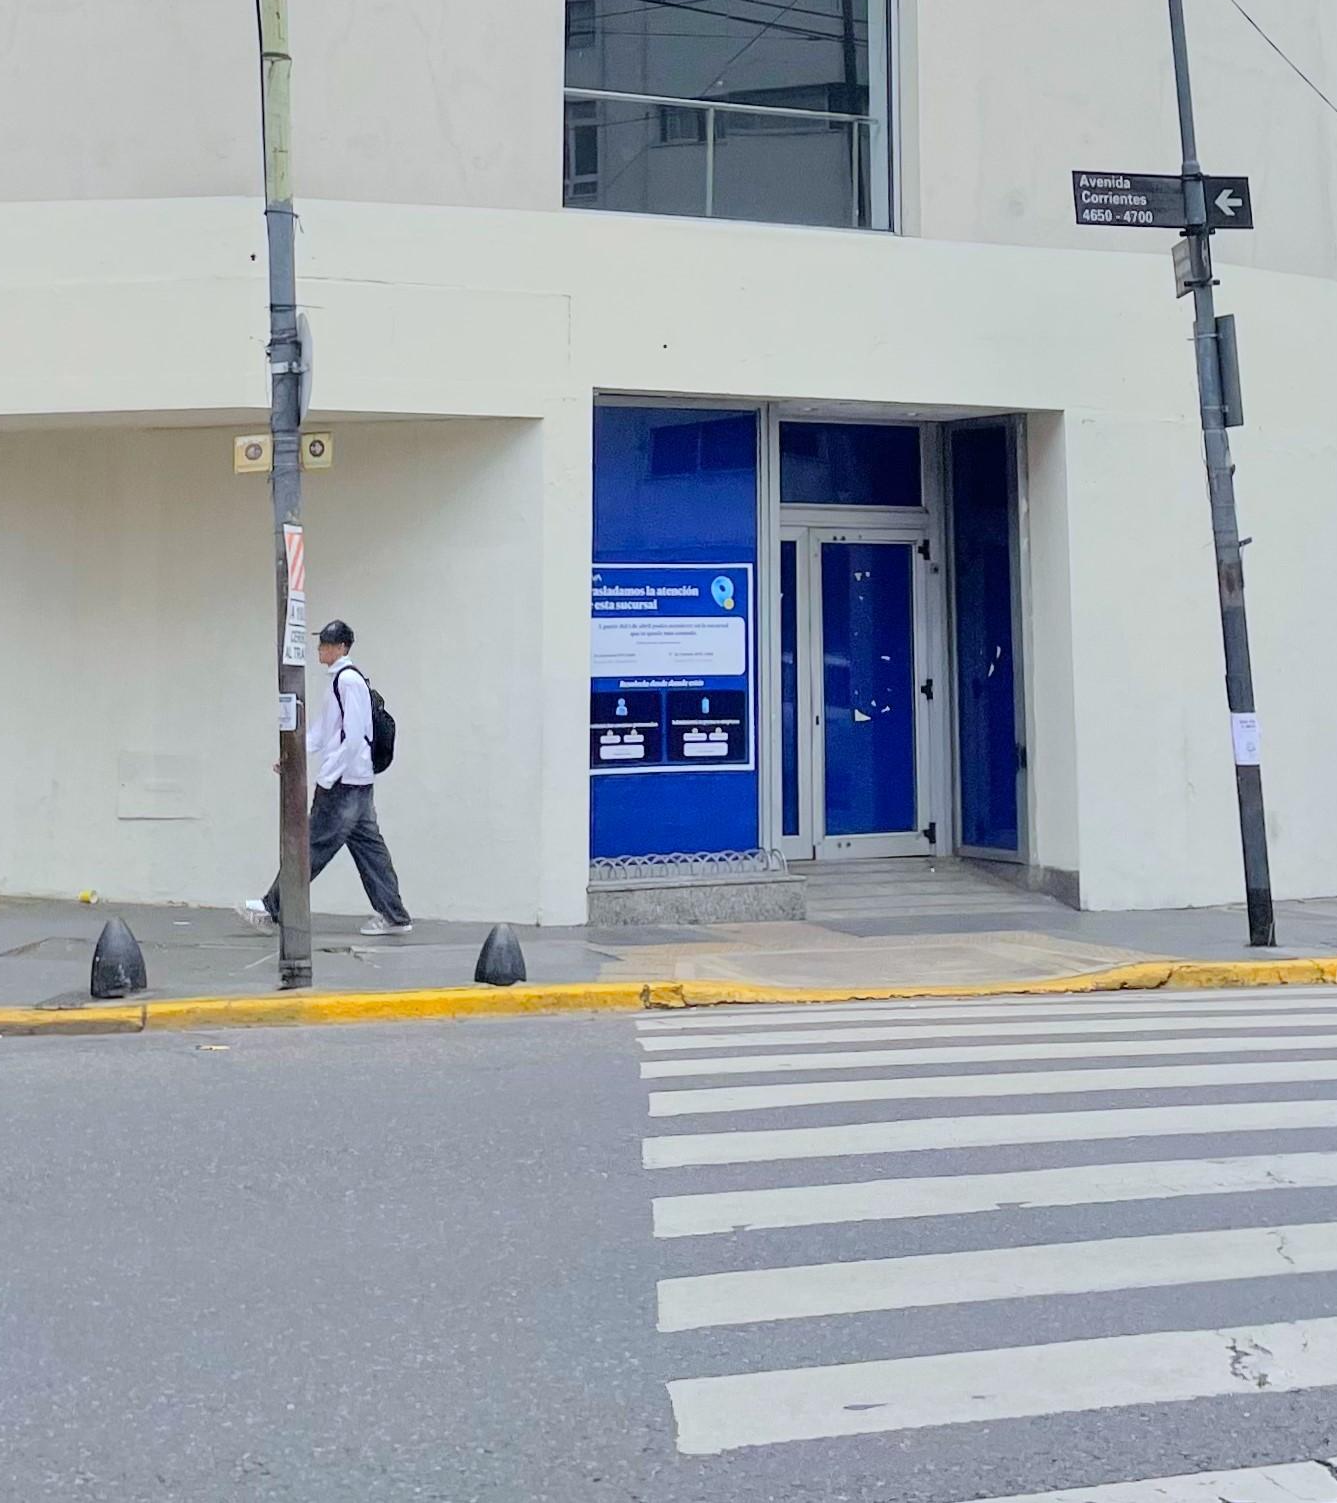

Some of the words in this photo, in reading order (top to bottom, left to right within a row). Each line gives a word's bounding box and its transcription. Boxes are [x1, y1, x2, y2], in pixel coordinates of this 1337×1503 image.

[1079, 174, 1131, 190] Avenida
[1081, 190, 1147, 206] Corrientes
[1082, 208, 1113, 223] 4650
[1123, 210, 1154, 224] 4700
[645, 585, 656, 597] la
[656, 585, 700, 597] atención
